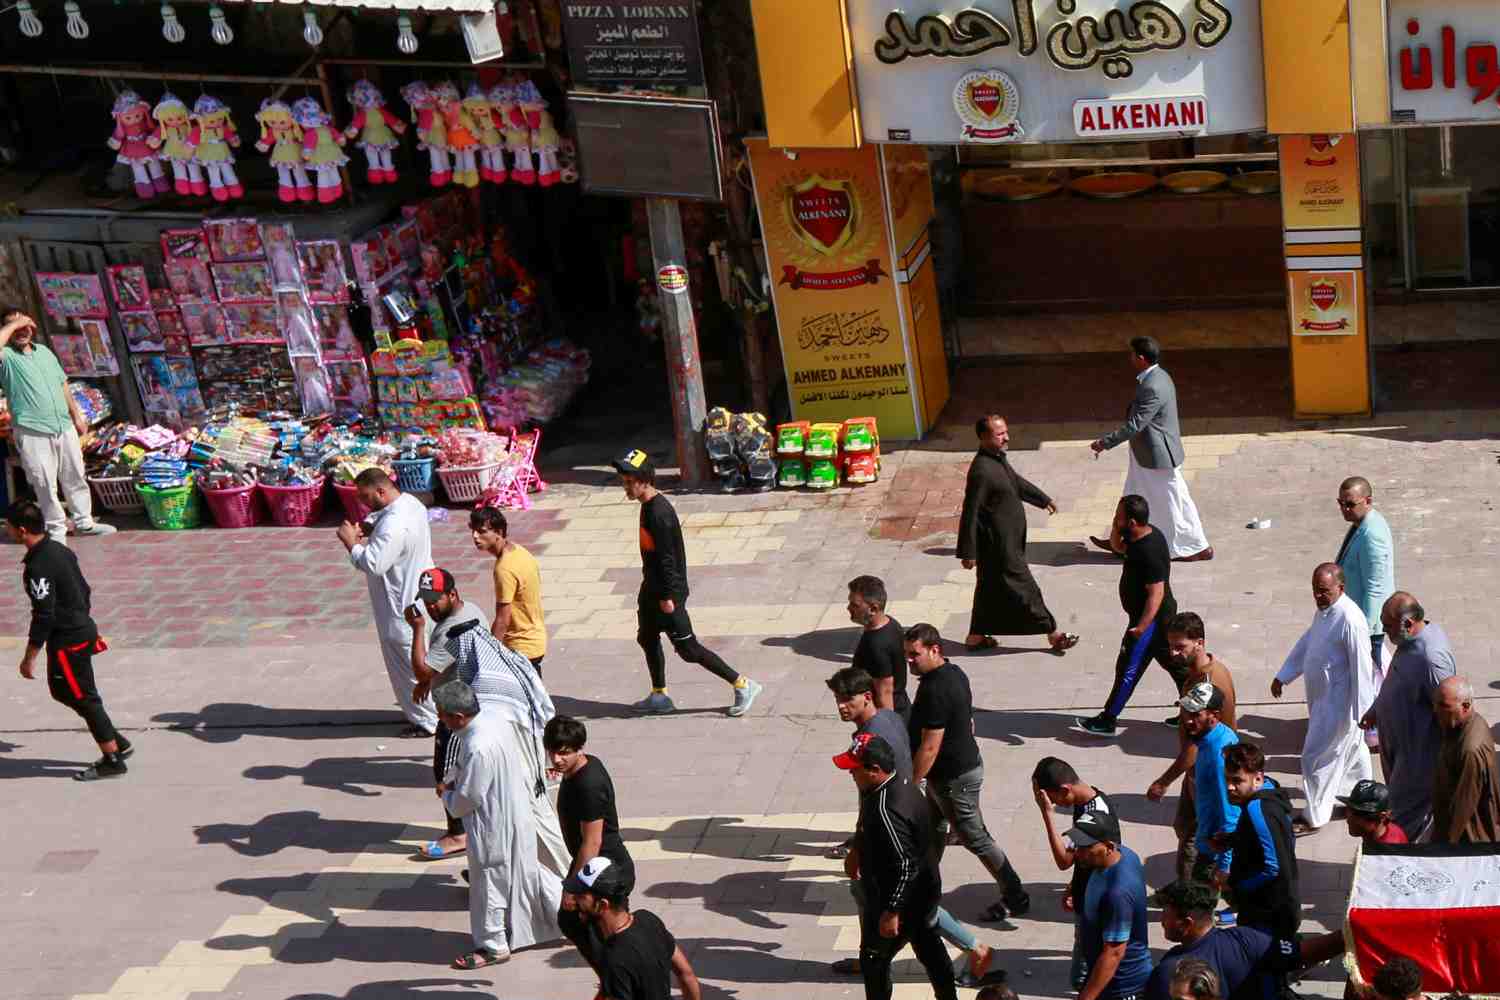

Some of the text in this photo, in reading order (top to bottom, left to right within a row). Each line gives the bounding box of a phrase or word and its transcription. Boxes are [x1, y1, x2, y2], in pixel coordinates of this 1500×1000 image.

[567, 6, 614, 18] PIZZA
[1046, 0, 1232, 79] دهين
[1080, 101, 1204, 131] ALKENANI
[798, 208, 848, 220] ALKENANY
[824, 352, 872, 361] SWEETS
[794, 363, 907, 384] AHMED ALKENANY
